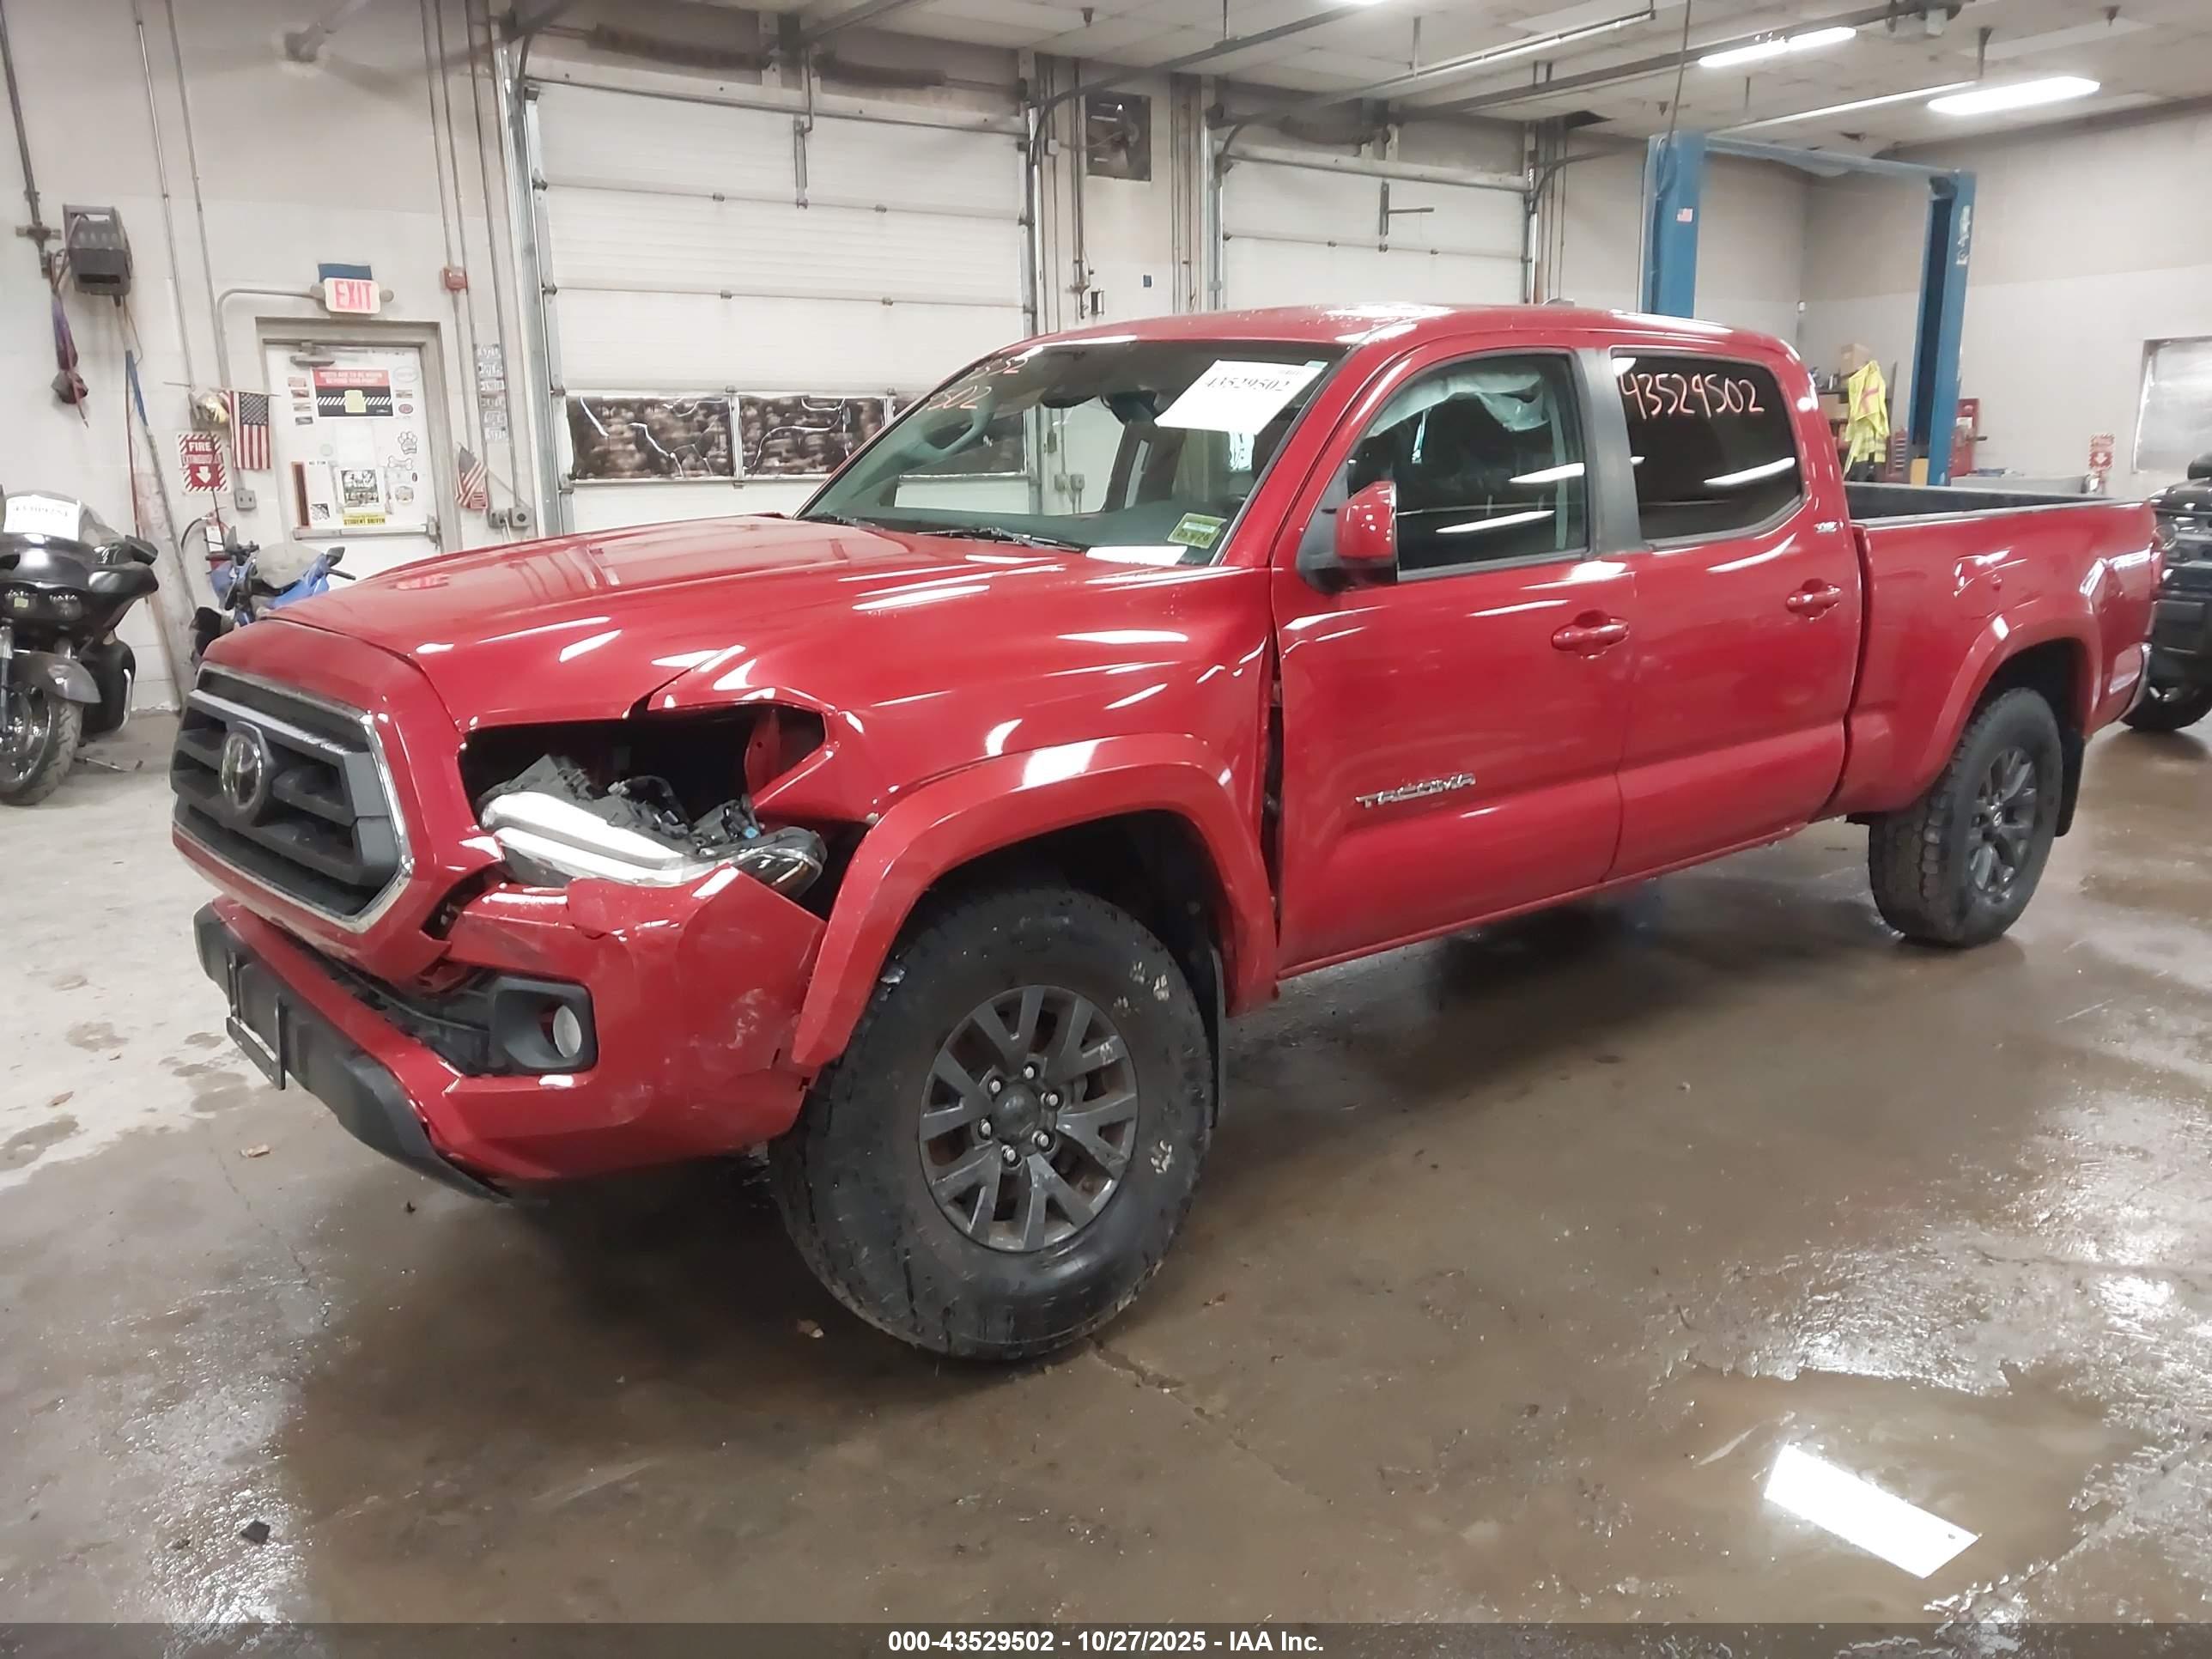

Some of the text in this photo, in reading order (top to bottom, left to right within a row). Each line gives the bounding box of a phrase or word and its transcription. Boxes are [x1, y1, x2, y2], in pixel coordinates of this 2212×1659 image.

[334, 279, 372, 310] EXIT
[1620, 373, 1765, 420] 43529502
[188, 441, 213, 453] FIRE
[1354, 774, 1476, 808] TACOMA
